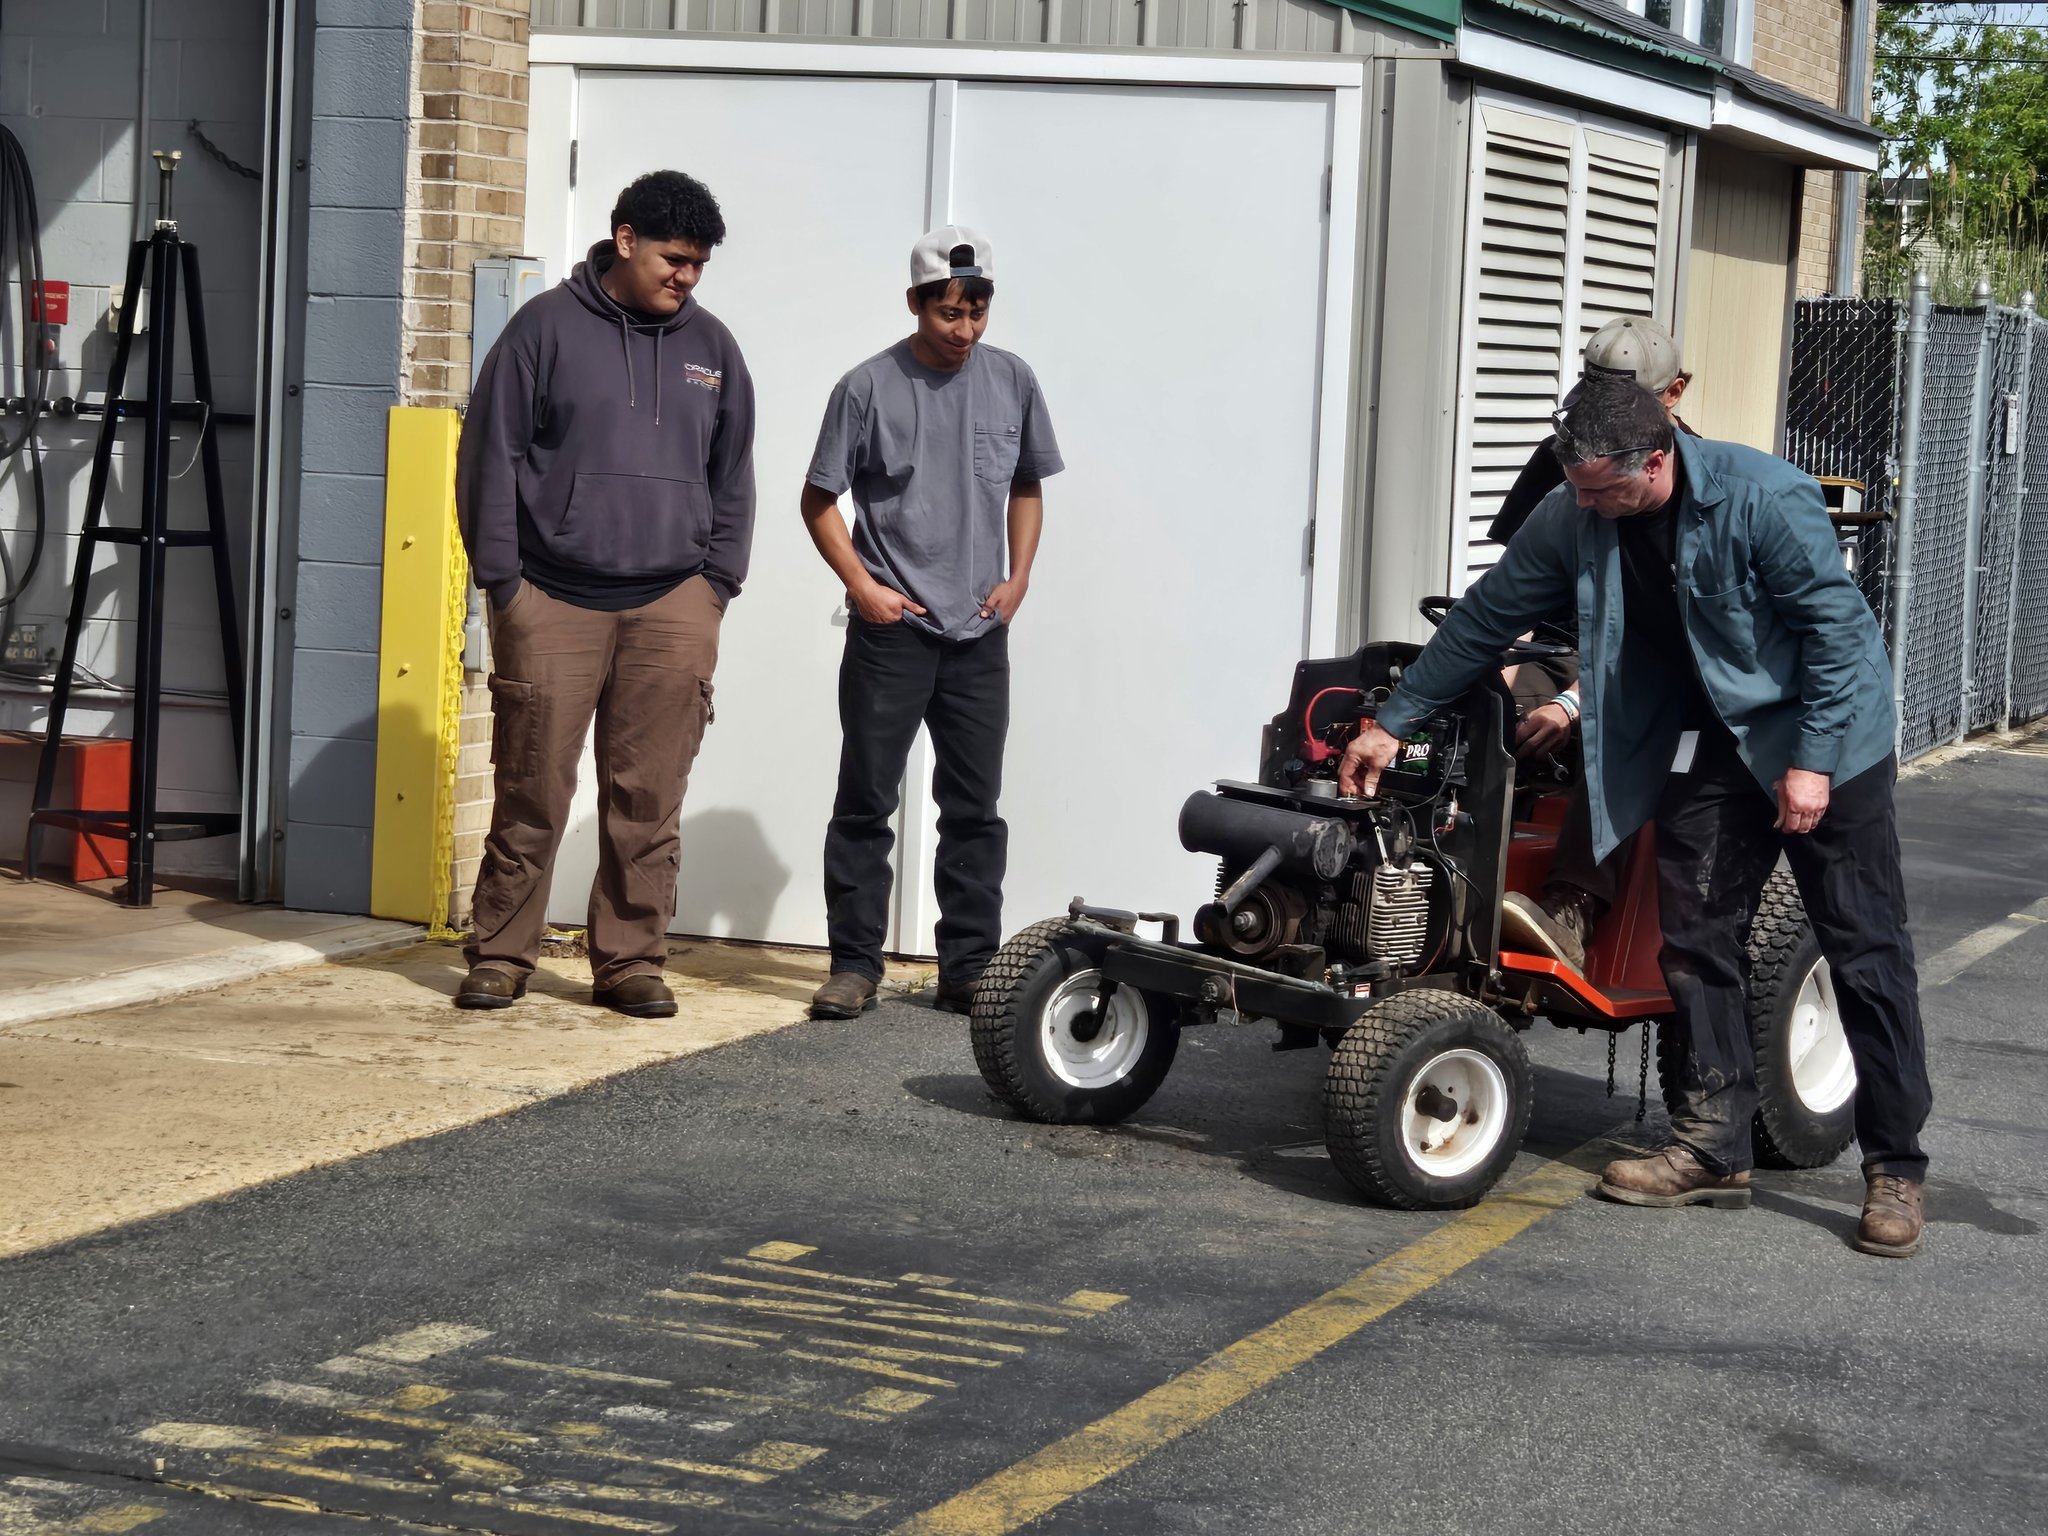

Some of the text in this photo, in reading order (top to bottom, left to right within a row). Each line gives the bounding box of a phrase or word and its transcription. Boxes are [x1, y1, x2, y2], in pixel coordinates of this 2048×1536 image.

[684, 363, 723, 378] ORACLE
[1406, 743, 1430, 758] PRO
[486, 1241, 1131, 1422] LANE
